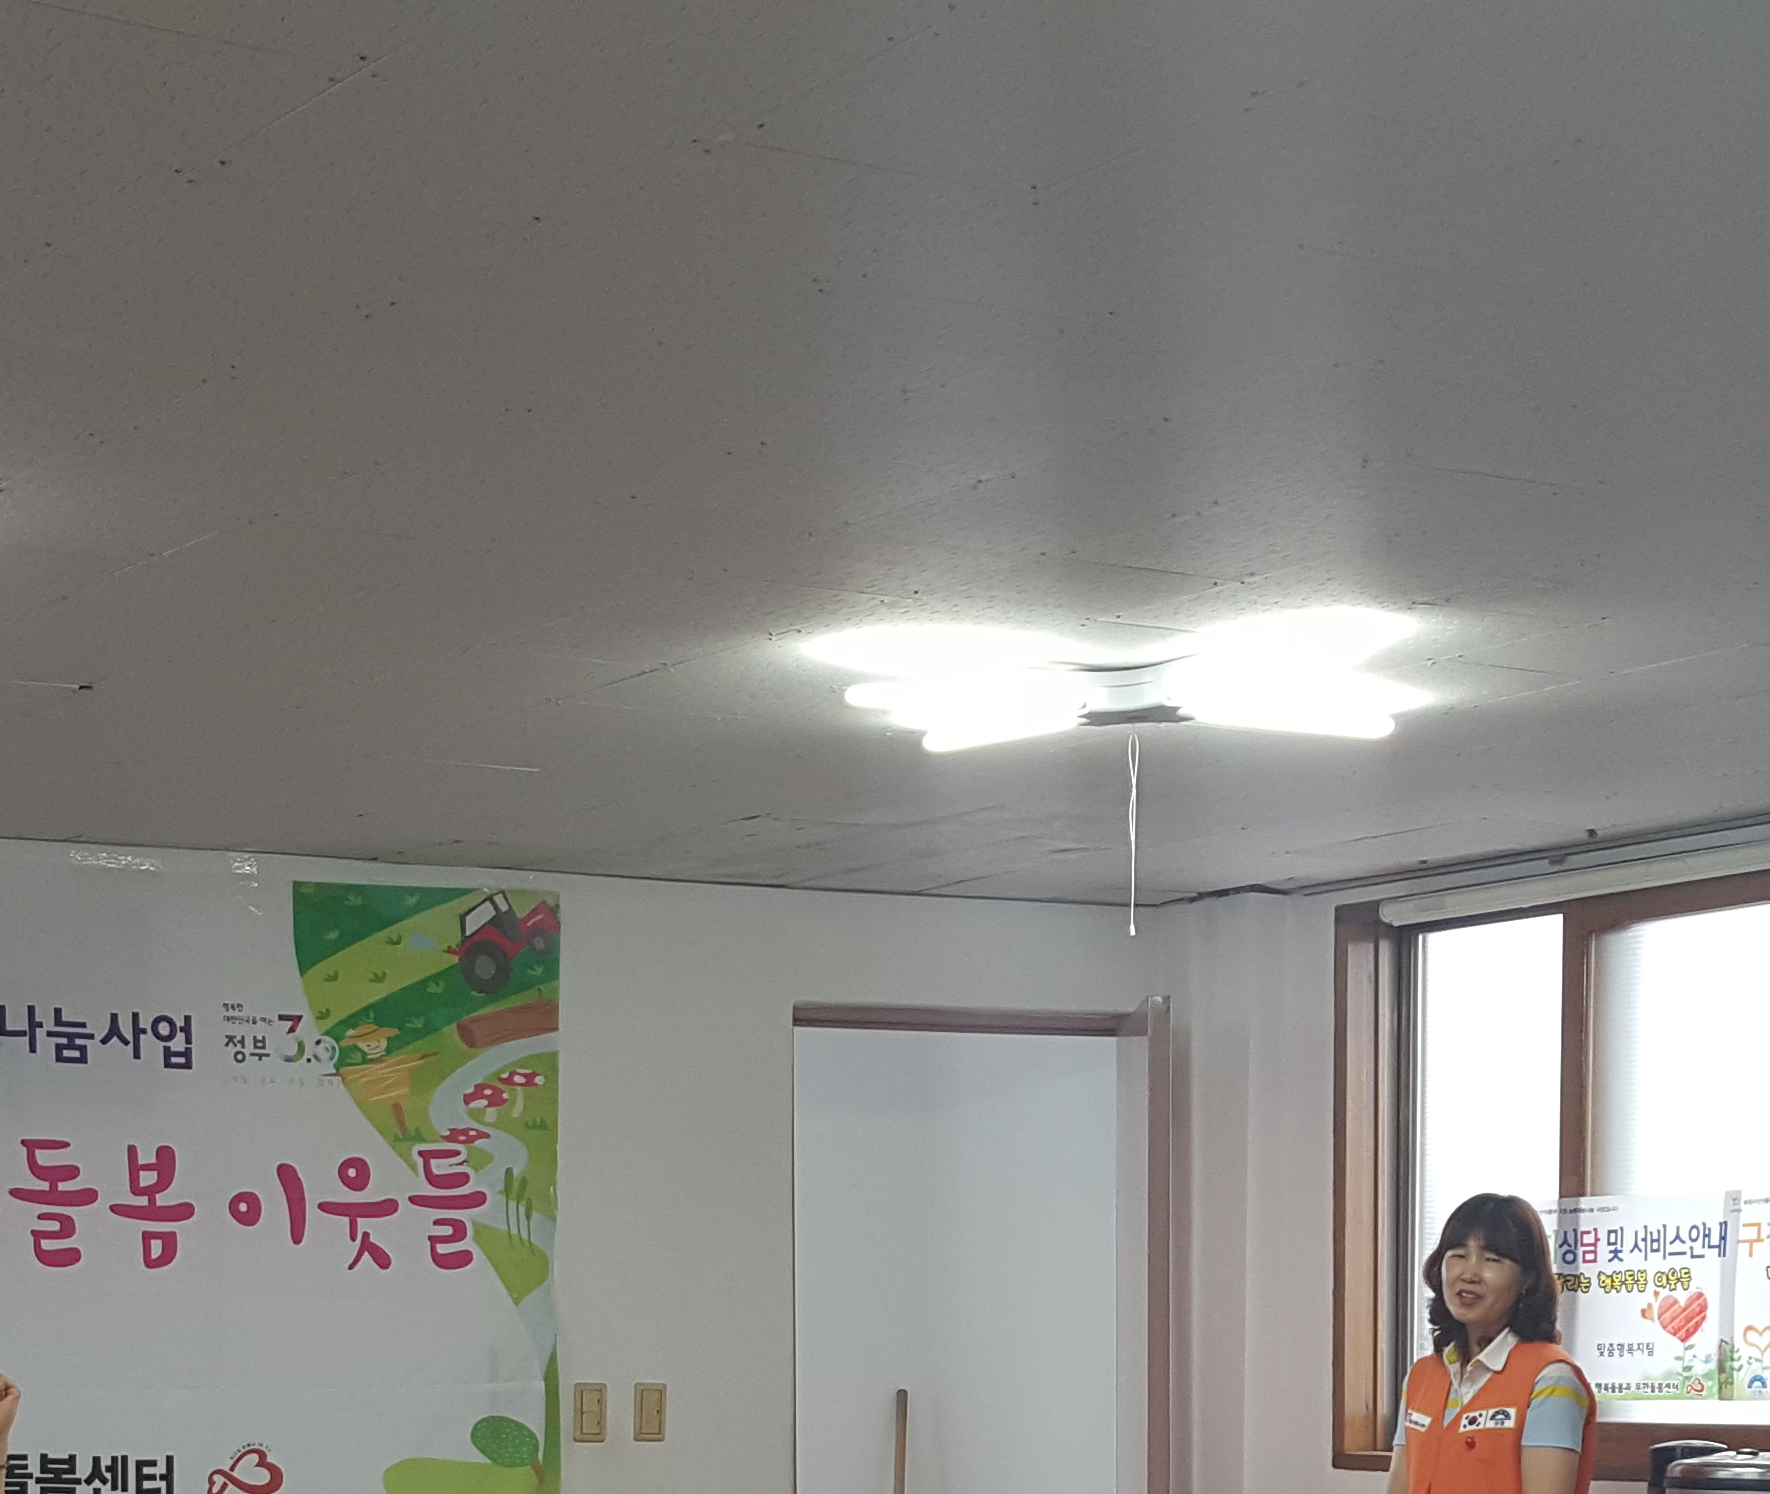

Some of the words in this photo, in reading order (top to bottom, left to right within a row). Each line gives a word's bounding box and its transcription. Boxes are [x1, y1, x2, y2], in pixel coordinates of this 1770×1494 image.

[224, 1035, 271, 1064] 정부
[228, 1144, 488, 1271] 이웃들
[1606, 1226, 1625, 1263] 및
[1629, 1219, 1729, 1262] 서비스안내
[1597, 1268, 1648, 1294] 행복돌봄
[1653, 1267, 1692, 1291] 이웃들
